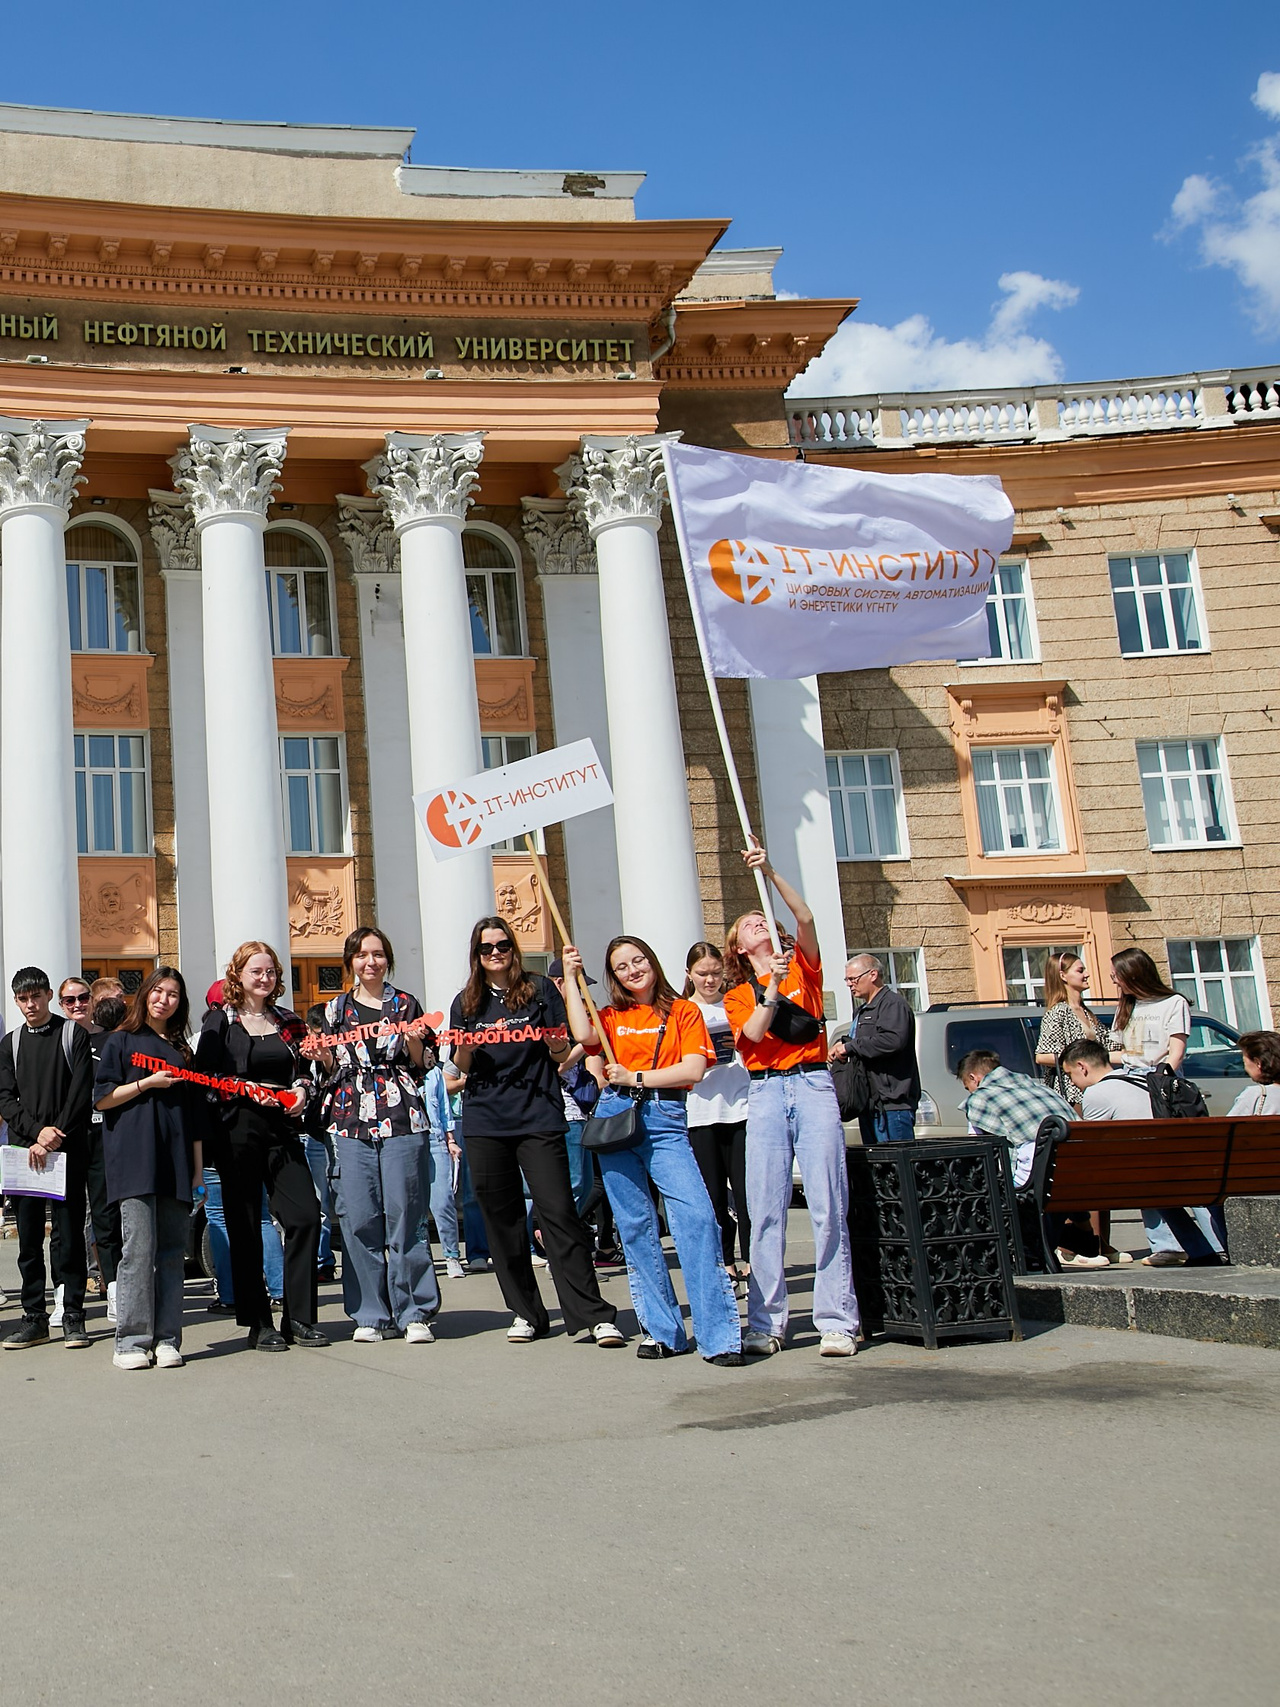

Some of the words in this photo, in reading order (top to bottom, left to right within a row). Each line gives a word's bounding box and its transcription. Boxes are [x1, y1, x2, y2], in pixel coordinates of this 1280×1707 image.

[84, 320, 227, 351] НЕФТЯНОЙ
[248, 329, 434, 359] ТЕХНИЧЕСКИЙ
[456, 336, 634, 363] УНИВЕРСИТЕТ
[786, 583, 852, 599] ЦИФРОВЫХ
[854, 588, 901, 601] СИСТЕМ,
[903, 581, 990, 601] АВТОМАТИЗАЦИИ
[789, 600, 797, 610] И
[800, 600, 863, 613] ЭНЕРГЕТИКИ
[866, 602, 899, 613] УГНТУ
[483, 763, 599, 816] IT-ИНСТИТУТ
